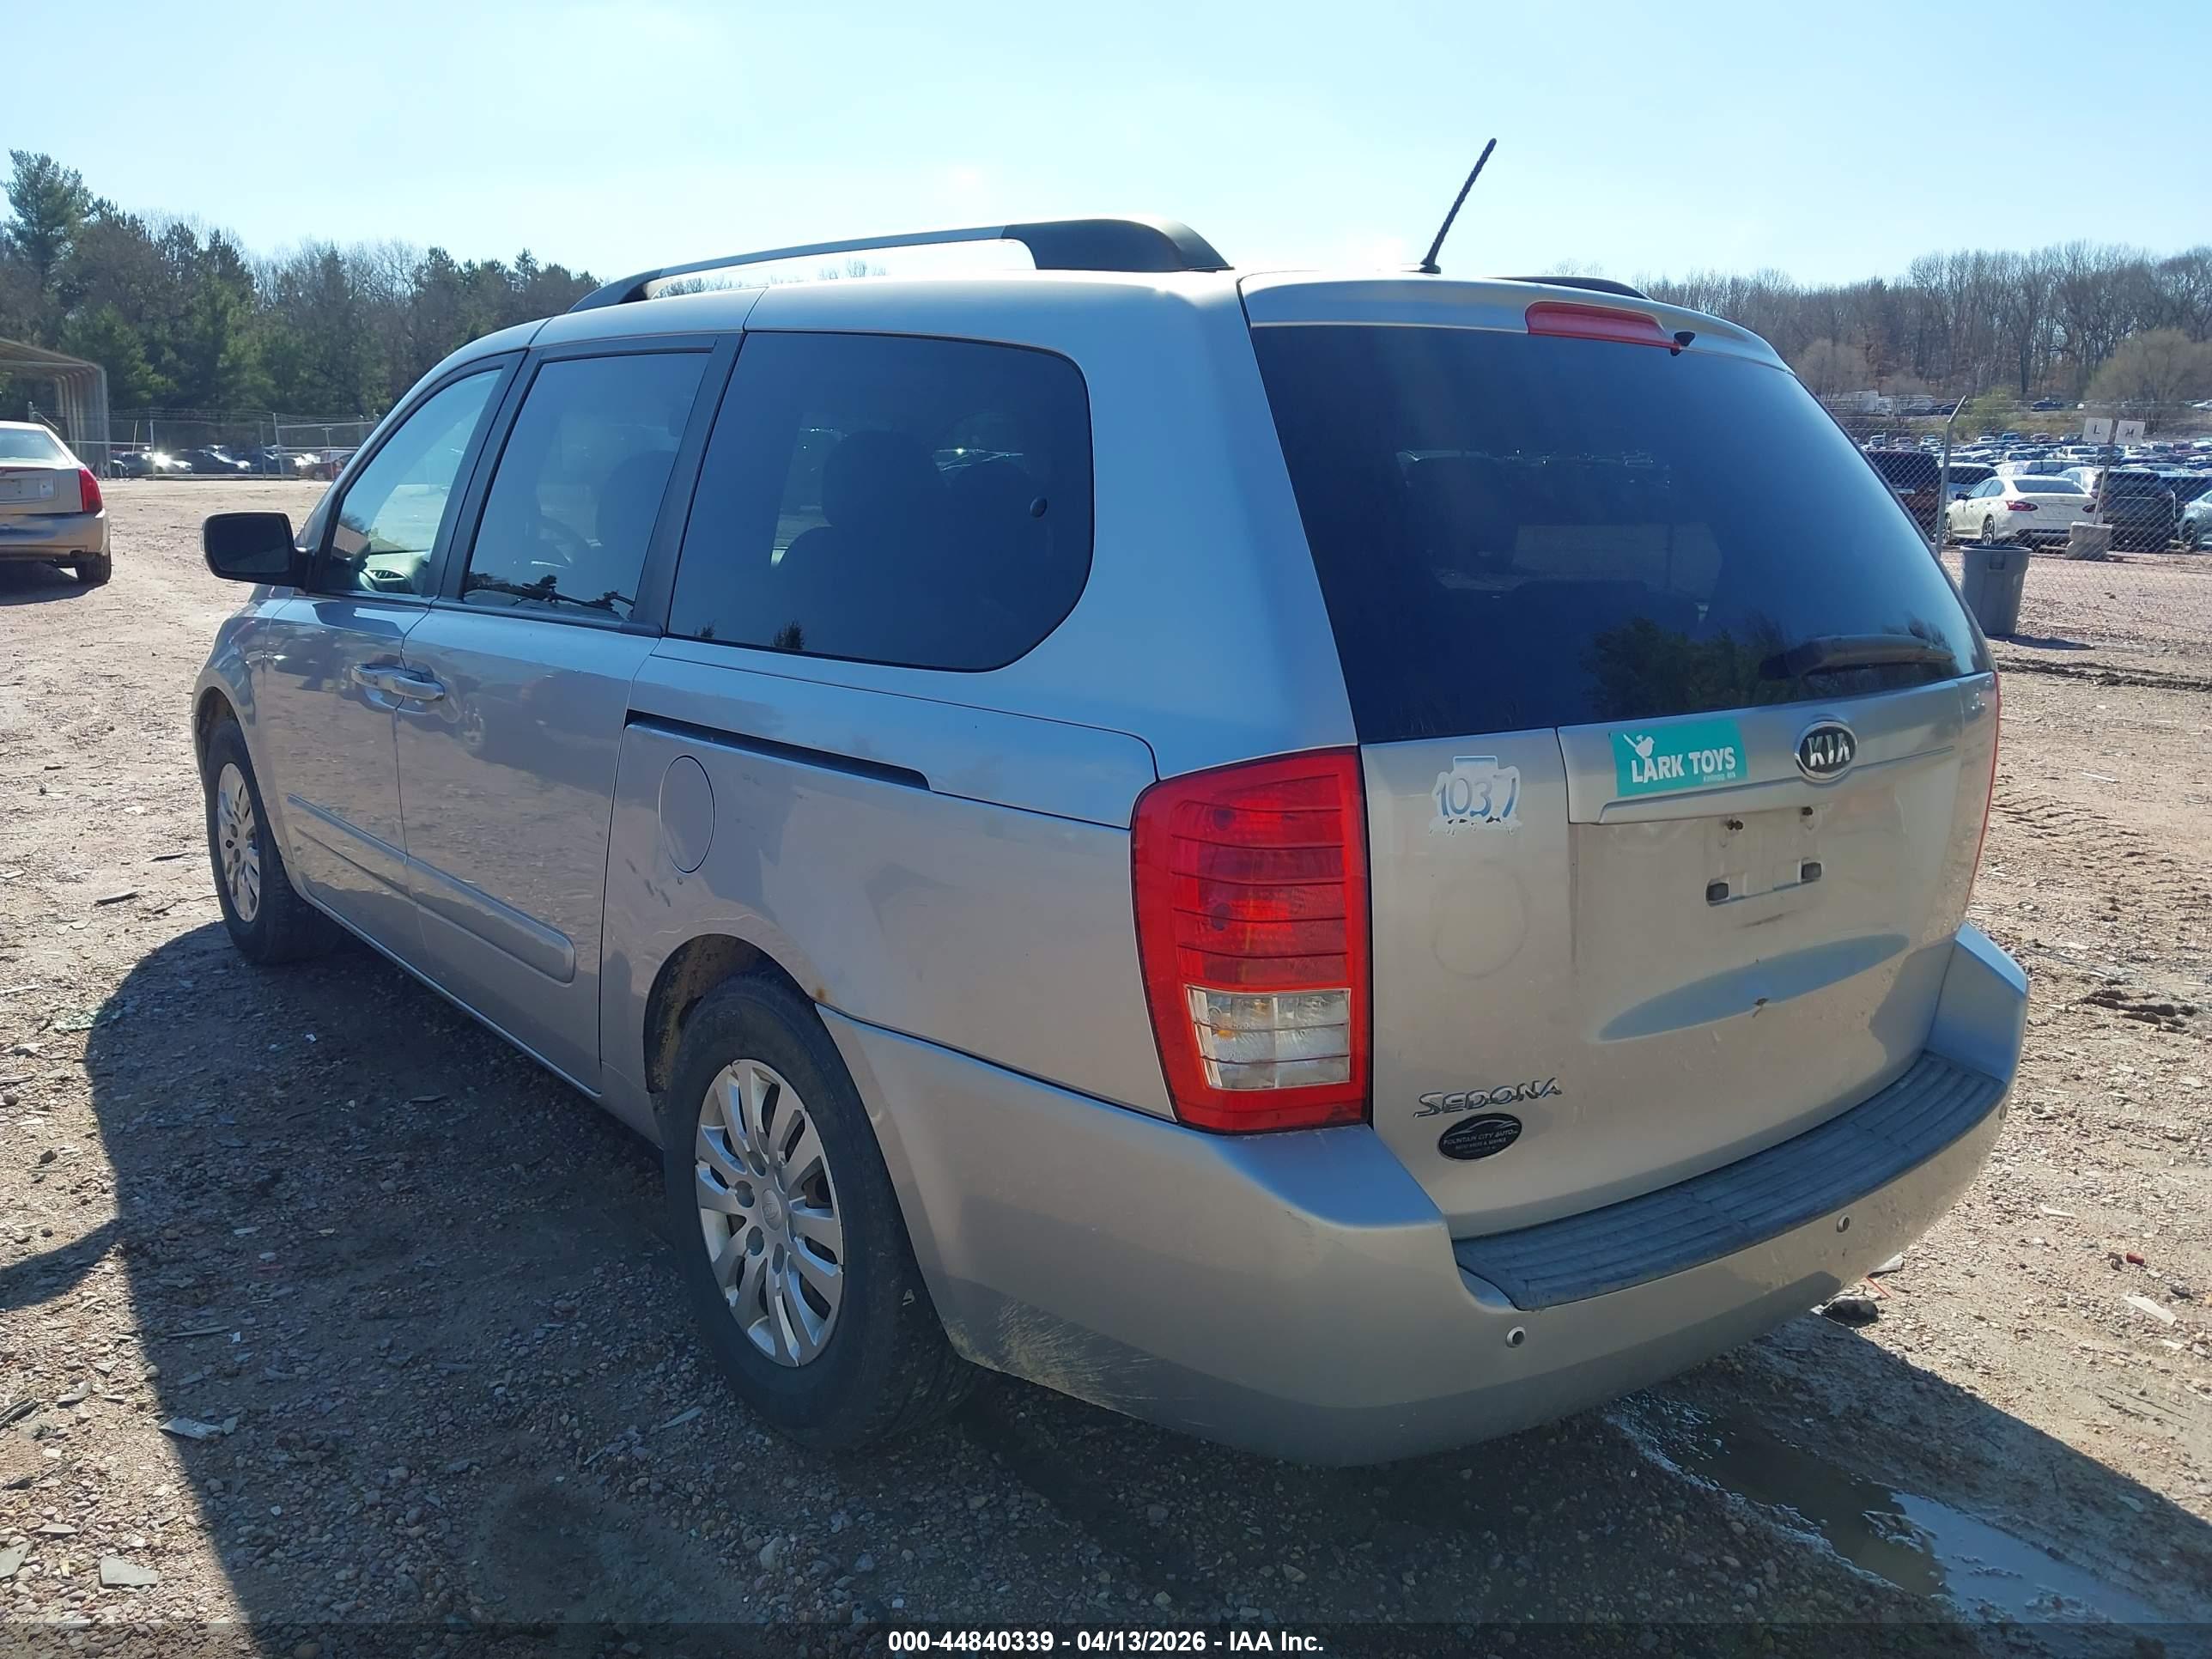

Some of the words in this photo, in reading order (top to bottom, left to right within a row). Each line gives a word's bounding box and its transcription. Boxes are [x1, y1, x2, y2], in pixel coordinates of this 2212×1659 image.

[2094, 424, 2101, 434] L
[1631, 754, 1685, 783] LARK
[1689, 747, 1736, 775] TOYS
[1808, 732, 1850, 767] KIA
[1436, 774, 1516, 818] 1037
[1413, 1077, 1562, 1118] SEDONA
[1495, 1129, 1514, 1138] AUTO
